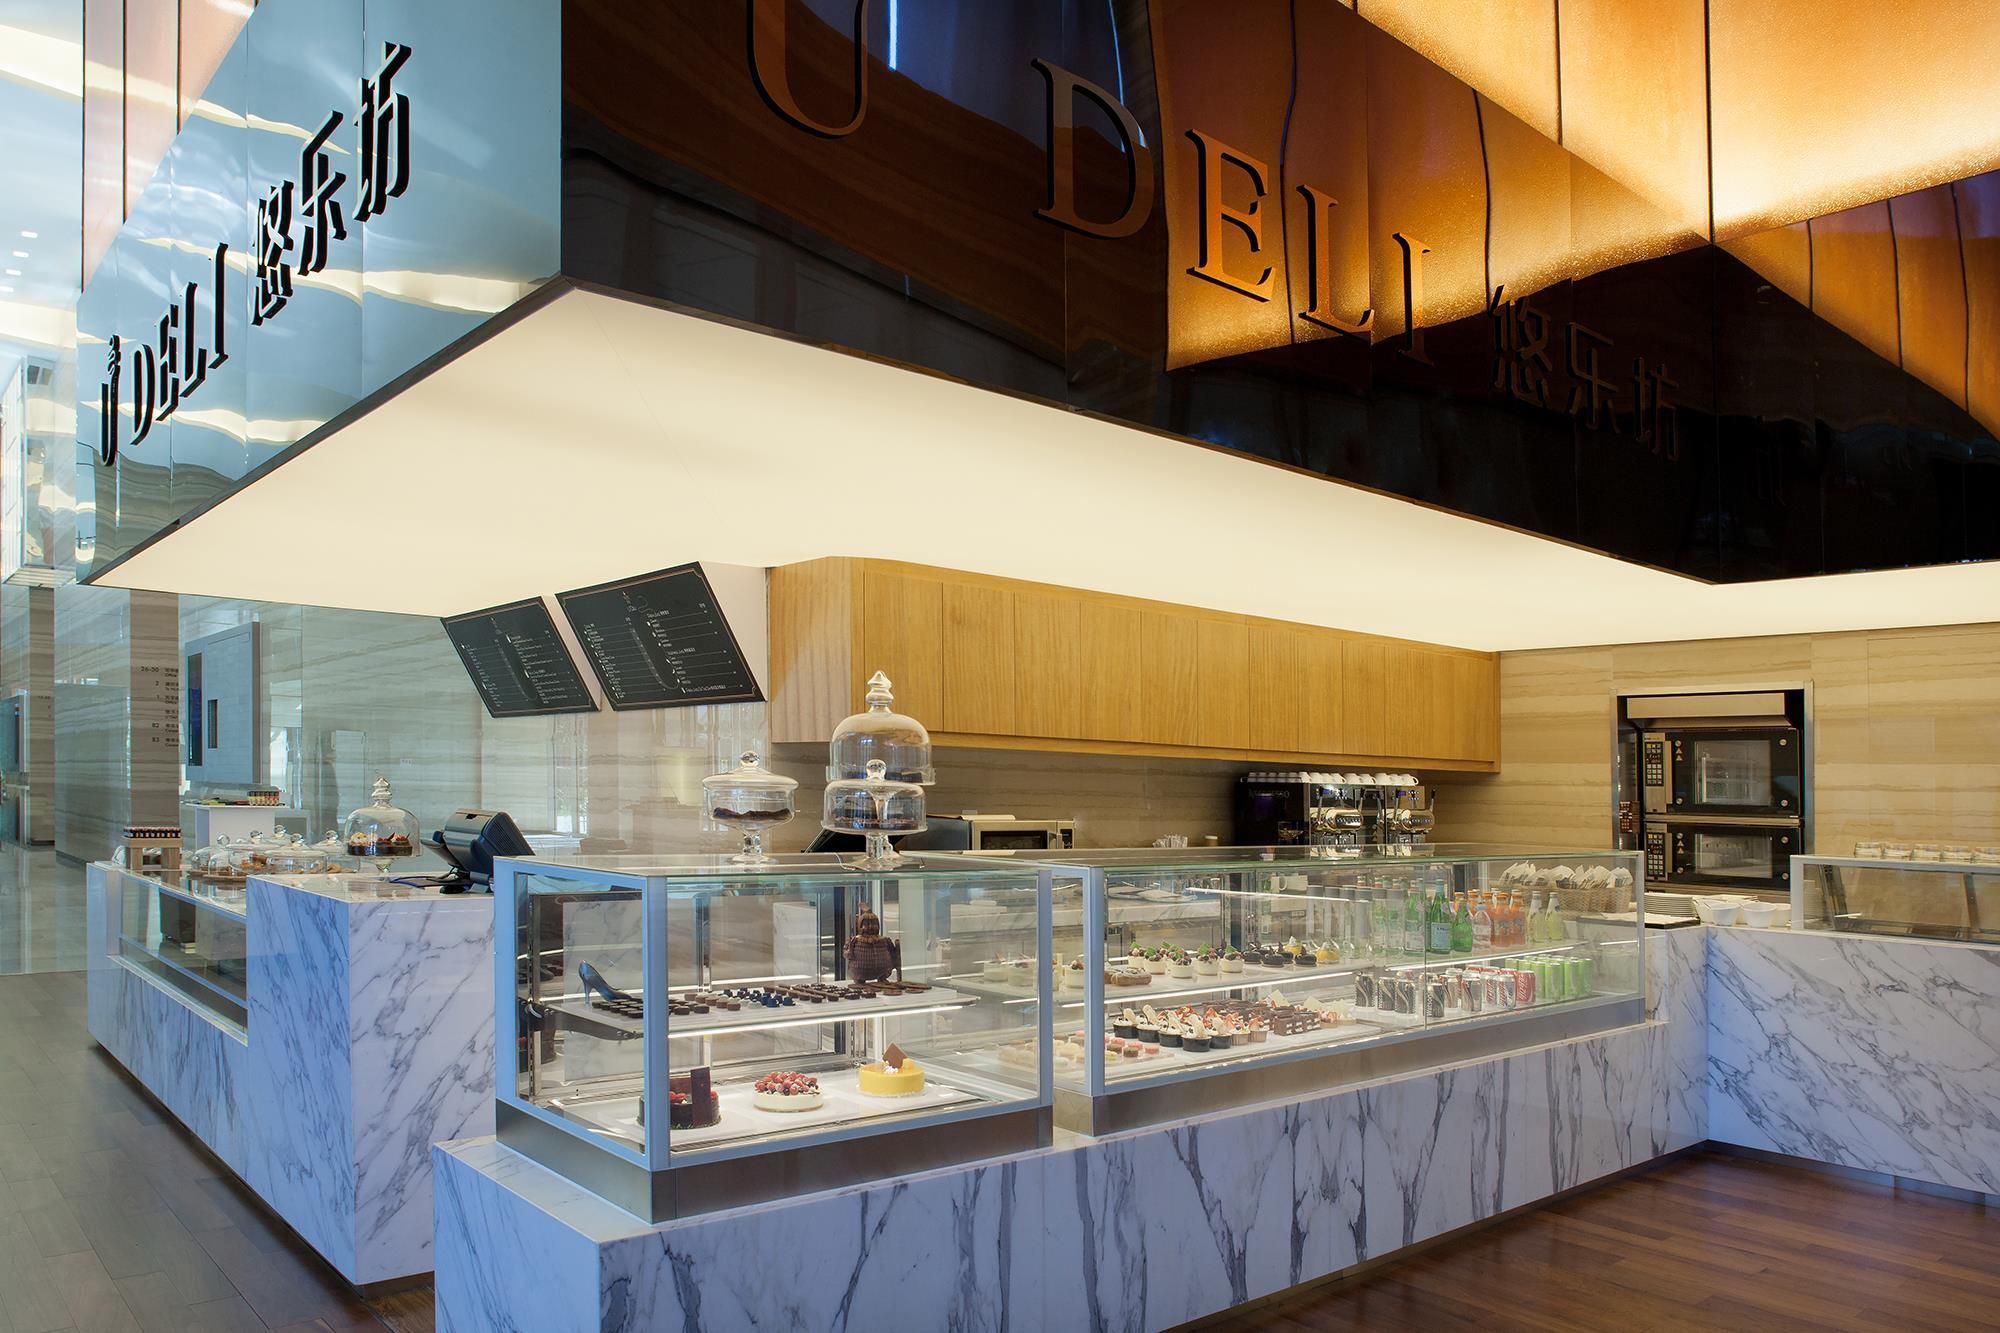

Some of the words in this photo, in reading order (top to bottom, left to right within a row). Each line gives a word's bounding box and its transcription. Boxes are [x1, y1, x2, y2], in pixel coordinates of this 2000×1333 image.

[252, 40, 413, 327] 悠乐坊
[1030, 57, 1436, 366] DELI
[130, 241, 229, 446] DELI
[1488, 284, 1680, 463] 悠乐坊
